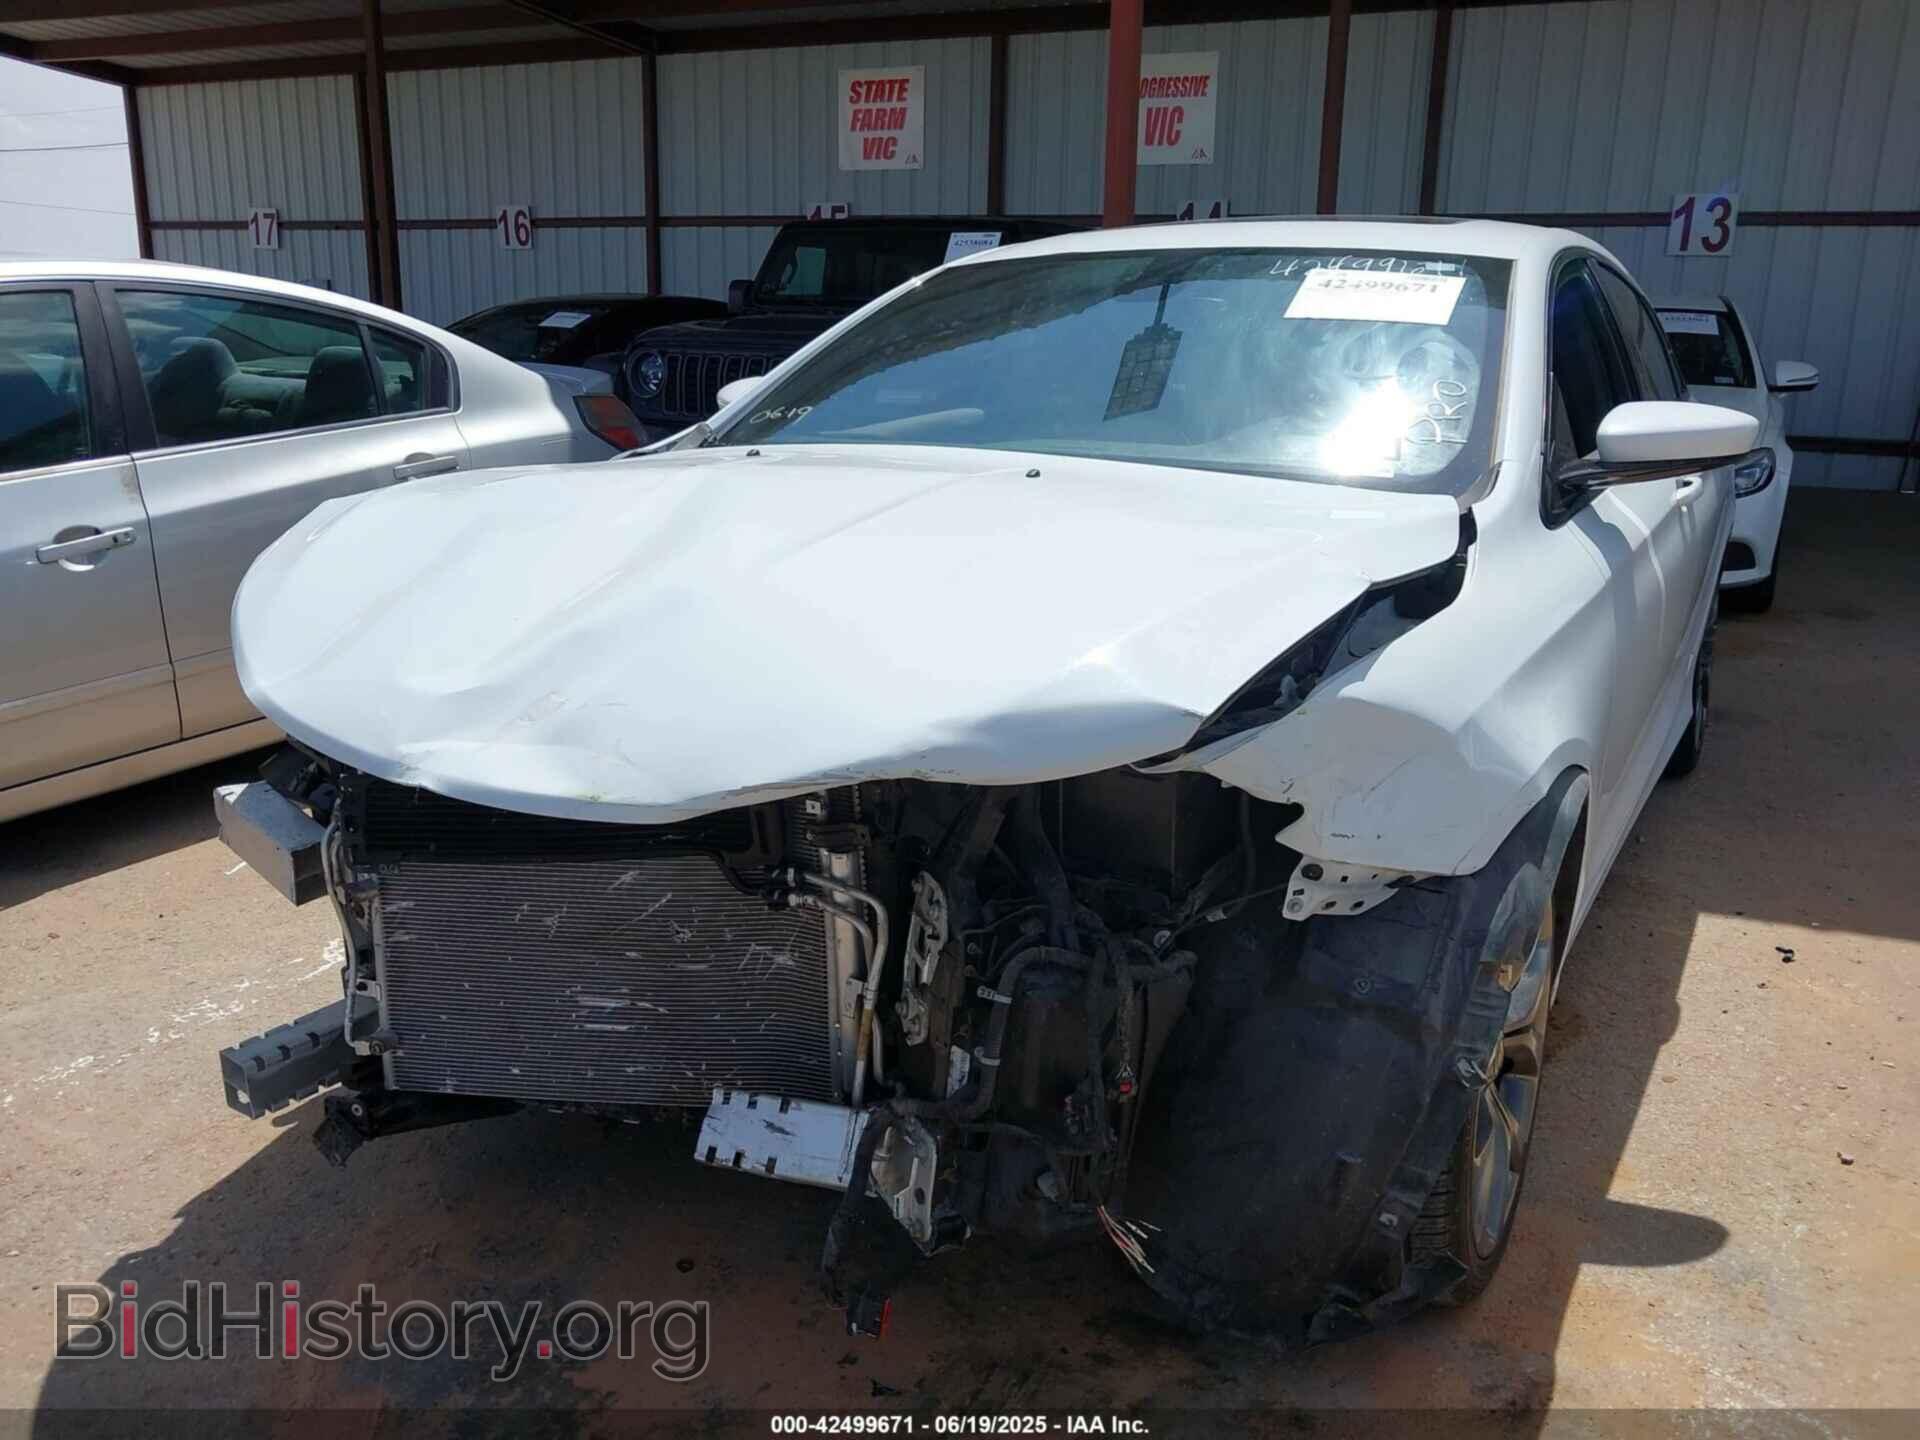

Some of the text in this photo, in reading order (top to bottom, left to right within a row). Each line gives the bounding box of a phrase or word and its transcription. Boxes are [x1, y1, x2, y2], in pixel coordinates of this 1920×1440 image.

[849, 79, 909, 104] STATE
[850, 107, 906, 132] FARM
[1144, 105, 1184, 147] VIC
[862, 136, 898, 161] VIC
[250, 211, 276, 246] 17
[498, 209, 530, 246] 16
[1673, 196, 1732, 253] 13
[1318, 279, 1439, 294] 42499671
